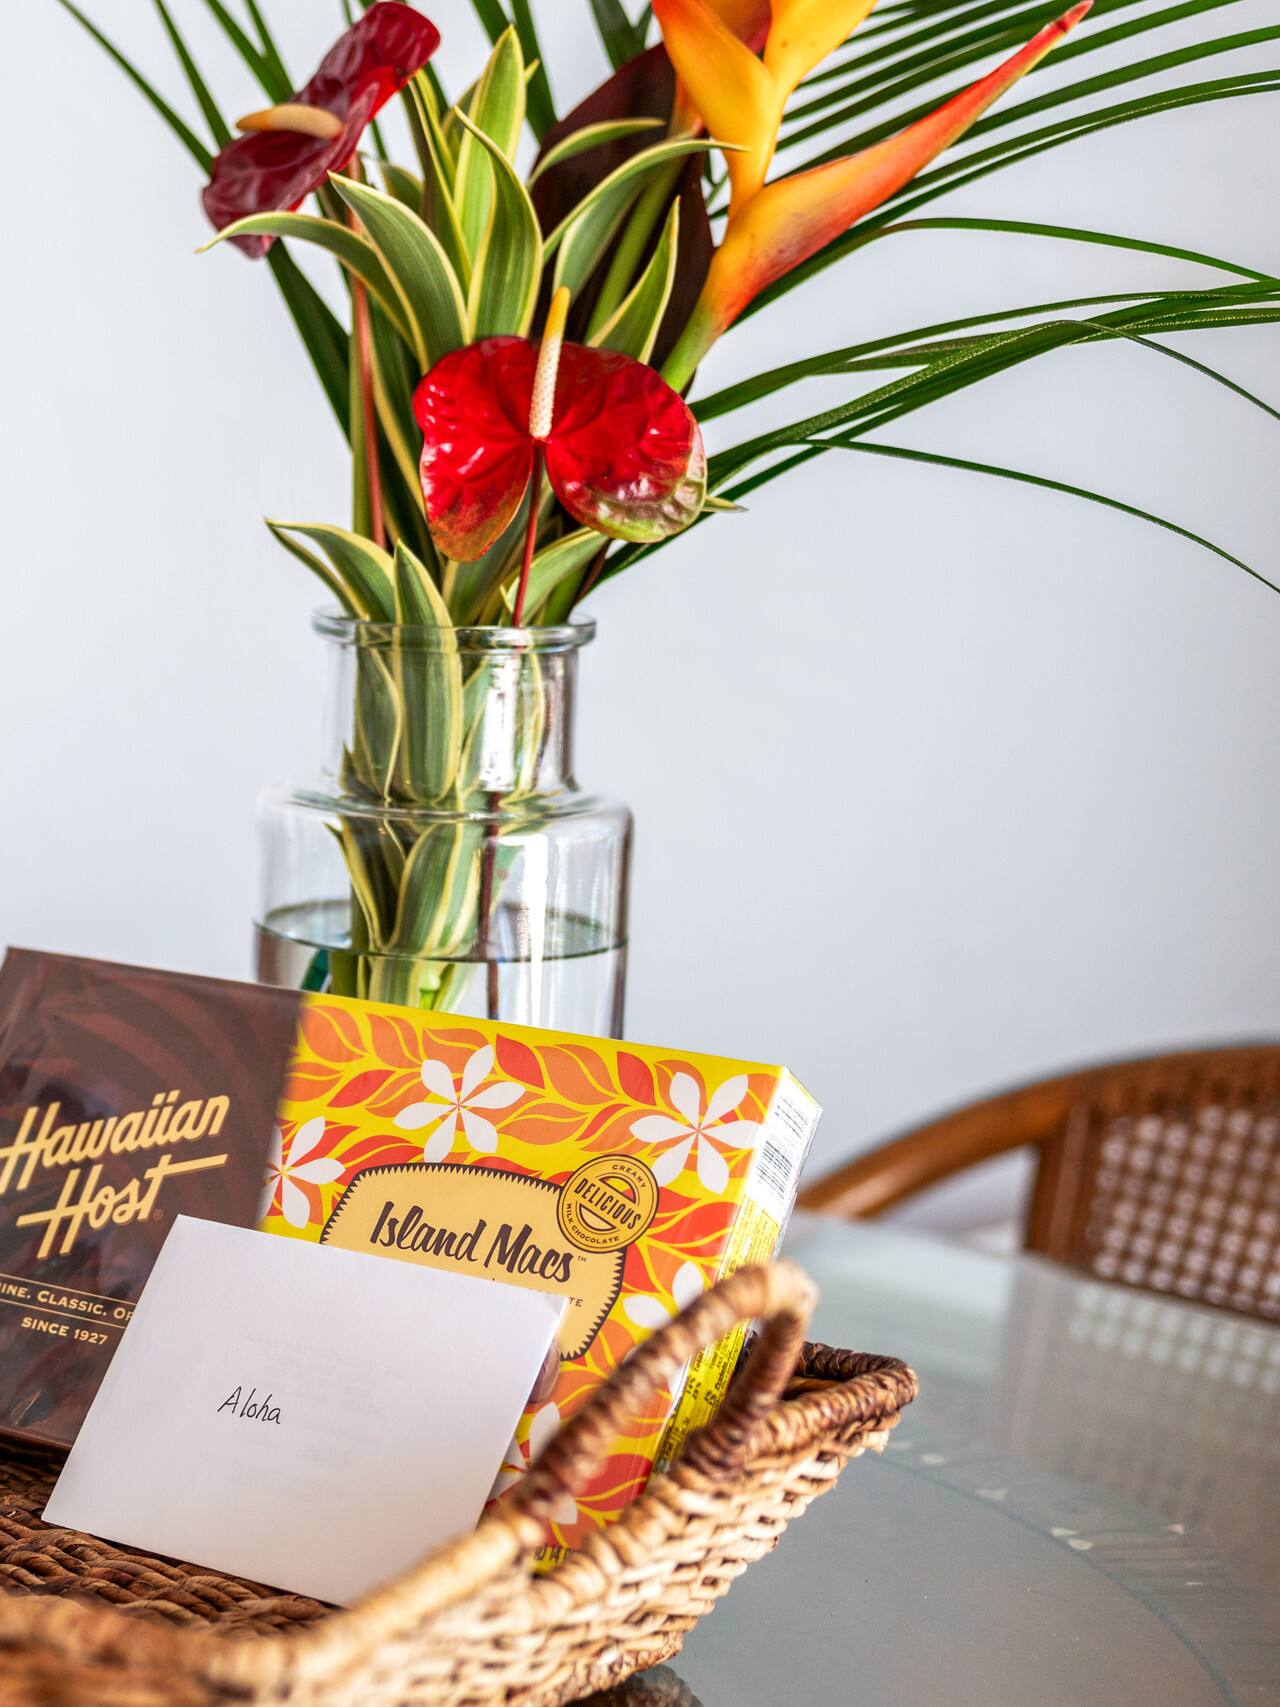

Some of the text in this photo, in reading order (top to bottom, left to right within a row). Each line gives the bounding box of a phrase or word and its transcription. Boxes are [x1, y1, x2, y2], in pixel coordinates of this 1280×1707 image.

[612, 1164, 647, 1189] CREAMY
[16, 1154, 228, 1260] Host
[566, 1203, 620, 1245] MILK CHOCOLATE
[573, 1177, 642, 1230] DELICIOUS
[370, 1200, 487, 1262] Island
[483, 1223, 574, 1283] Macs
[37, 1290, 108, 1316] CLASSIC.
[21, 1317, 108, 1345] SINCE 1927
[216, 1385, 281, 1425] Aloha
